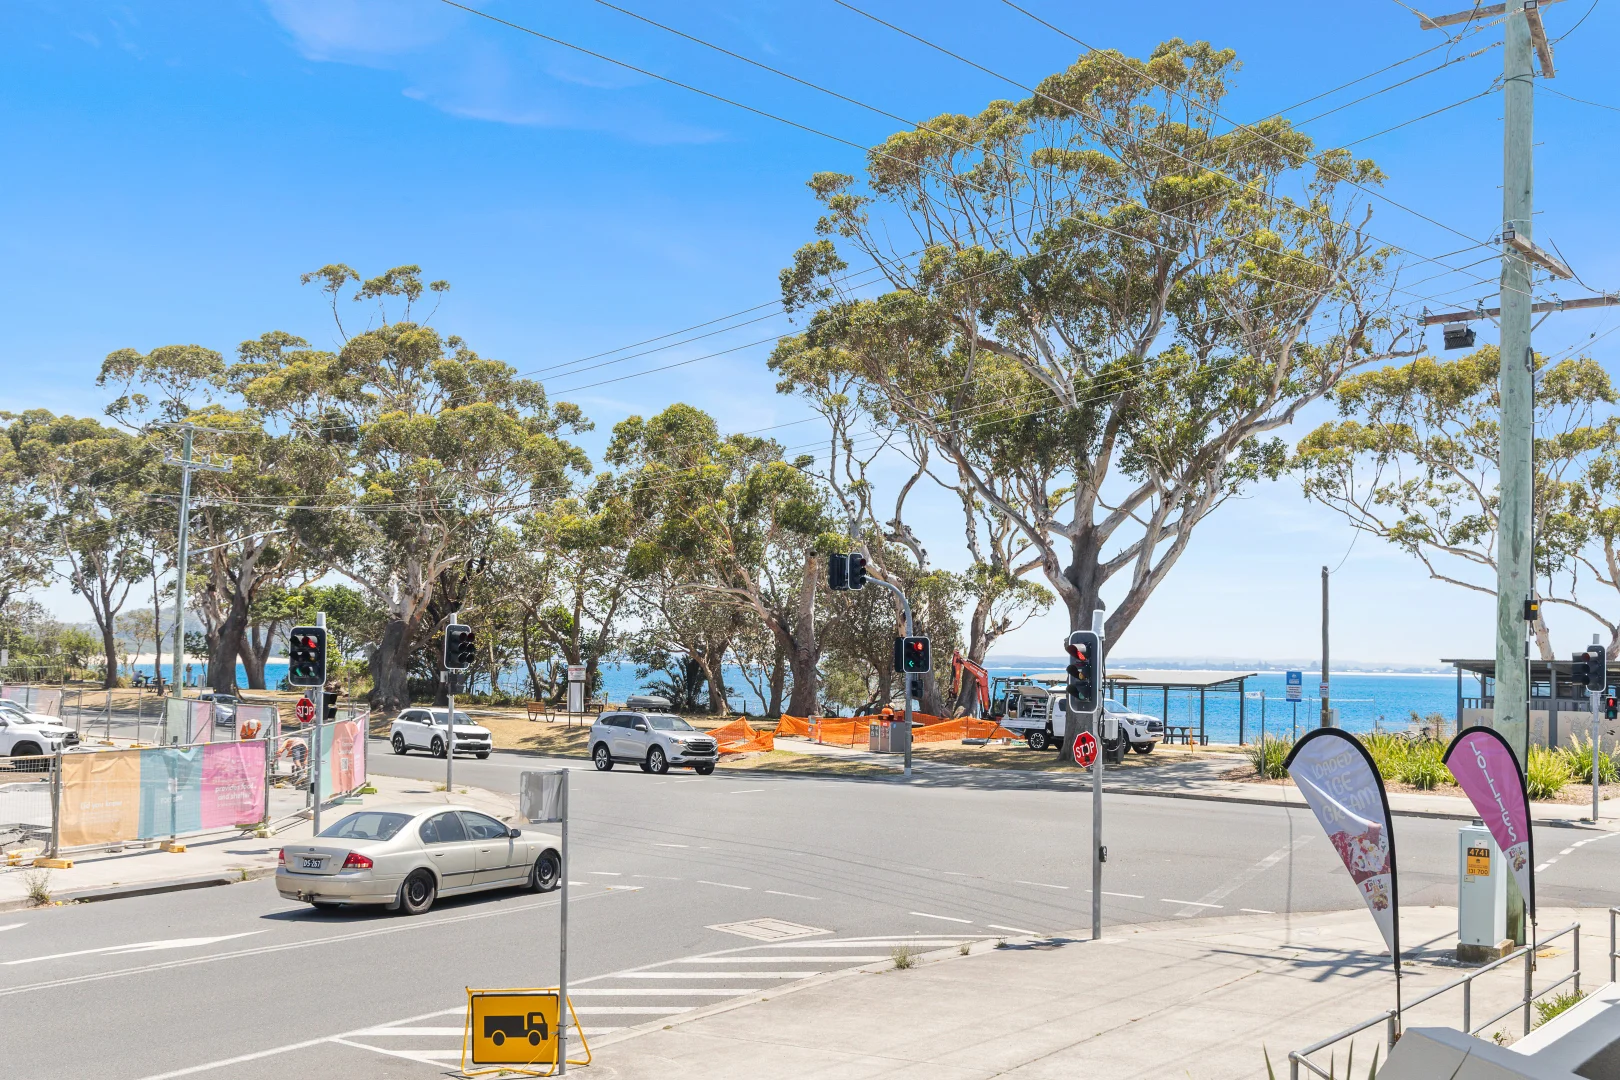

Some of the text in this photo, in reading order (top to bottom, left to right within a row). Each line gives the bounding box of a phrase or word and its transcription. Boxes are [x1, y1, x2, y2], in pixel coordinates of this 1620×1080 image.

[296, 705, 313, 717] STOP
[1075, 741, 1095, 758] STOP
[1311, 751, 1353, 779] LOADED
[1324, 771, 1353, 798] ICE
[1469, 741, 1517, 843] LOLLIES
[1469, 848, 1488, 857] 4741
